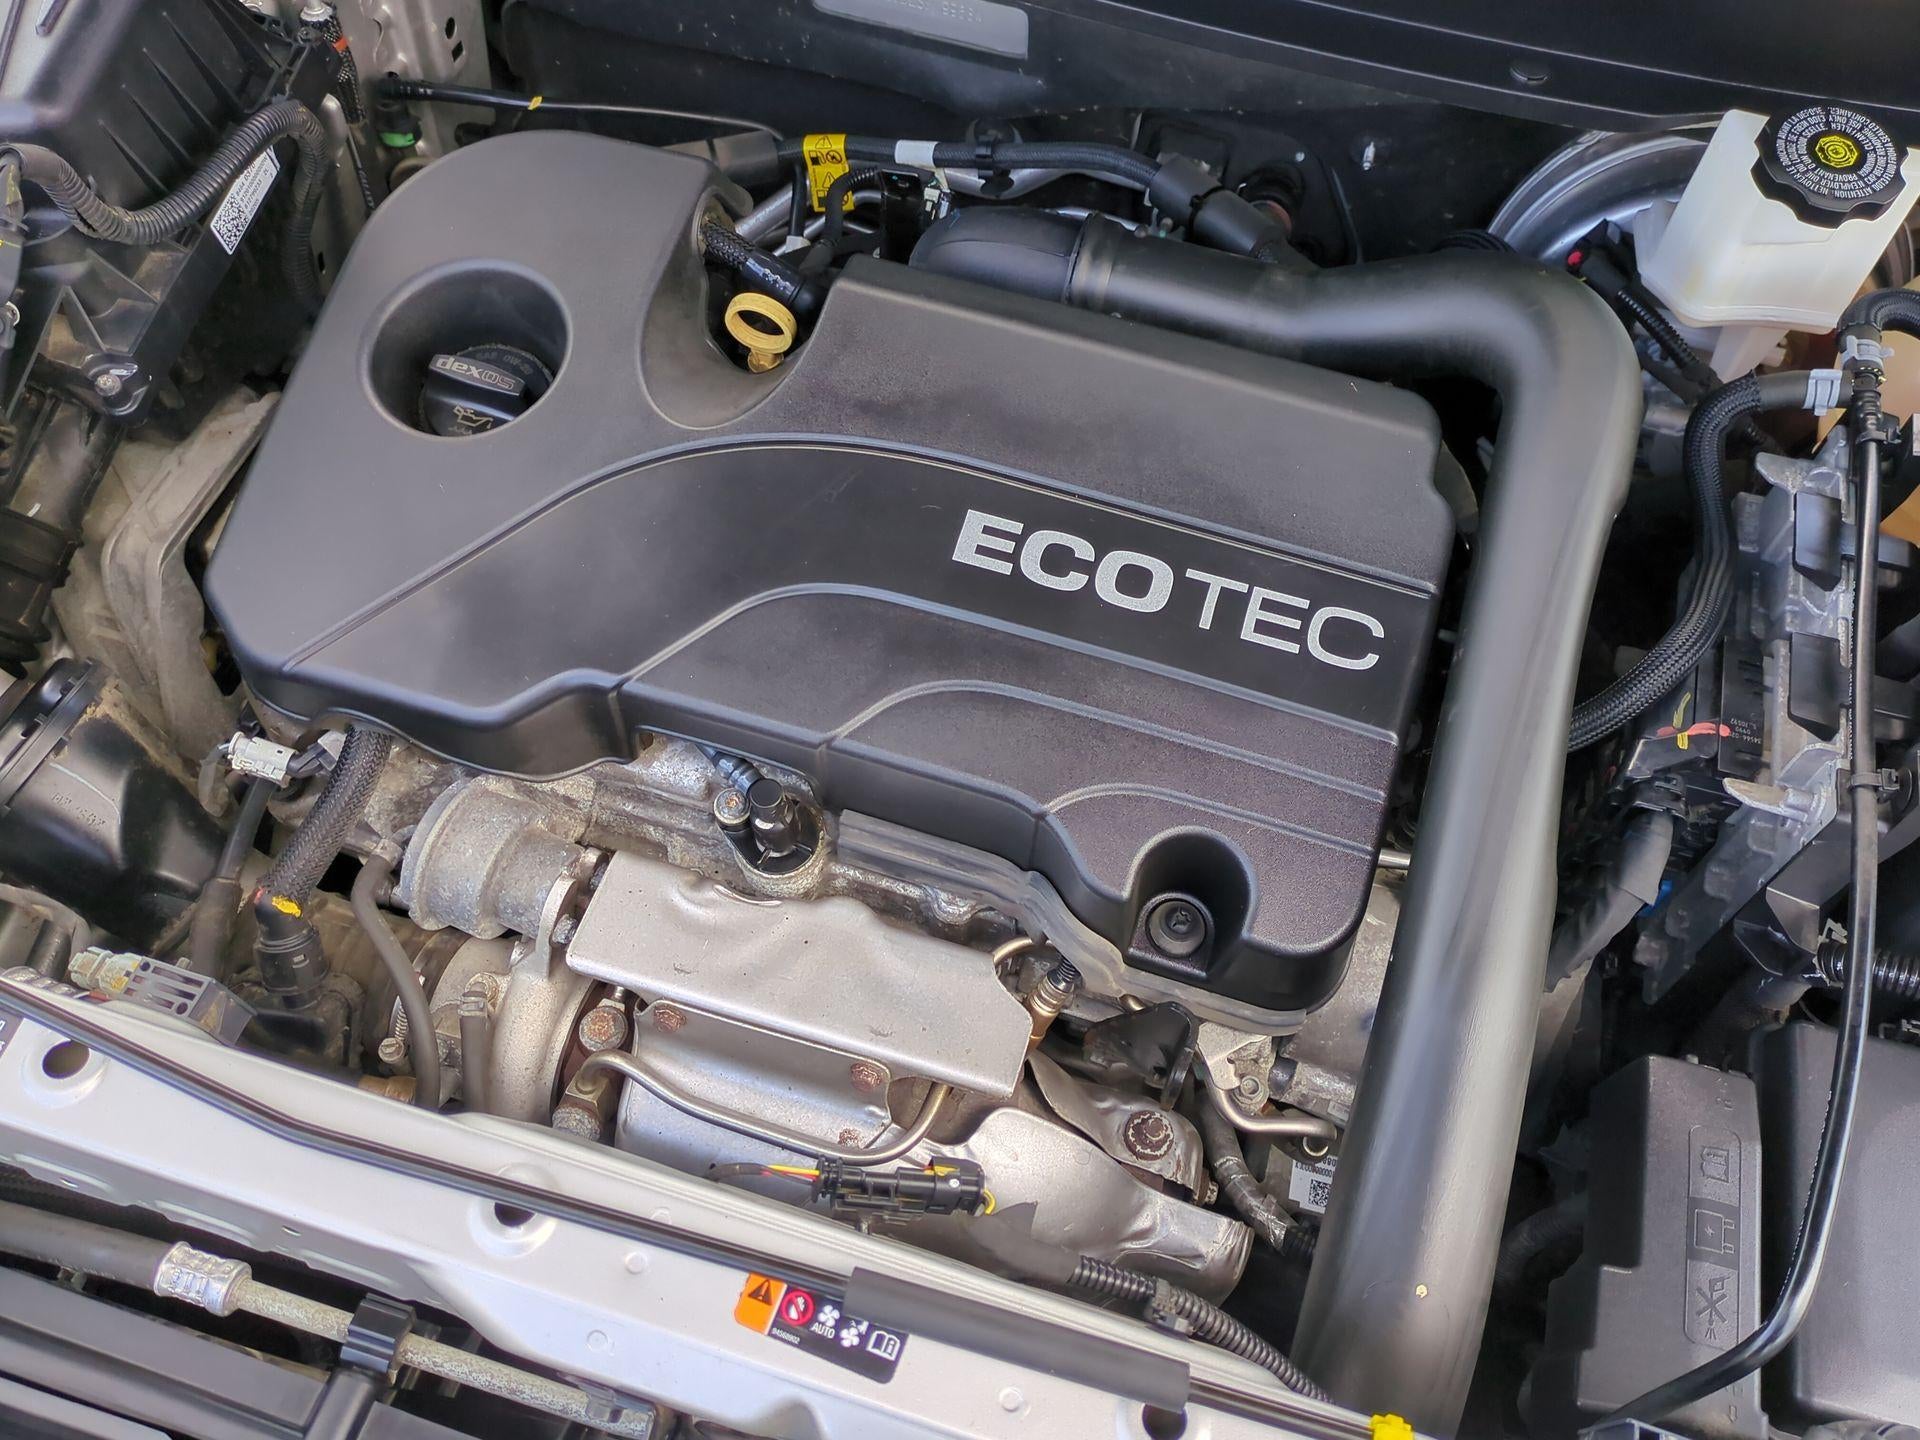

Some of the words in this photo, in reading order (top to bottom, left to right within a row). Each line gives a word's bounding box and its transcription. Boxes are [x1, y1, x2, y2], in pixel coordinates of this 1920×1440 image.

[1789, 116, 1799, 124] LA
[1827, 114, 1847, 123] ONLY
[1847, 118, 1862, 129] USE
[1777, 122, 1792, 138] AVANT
[1791, 120, 1809, 134] FREIN
[1830, 122, 1857, 134] FILLER
[1867, 122, 1890, 142] SEALED
[1787, 133, 1798, 141] DE
[1797, 136, 1807, 153] BIDON
[1854, 131, 1874, 149] CLEAN
[1777, 138, 1791, 165] BOUCHON
[1787, 141, 1800, 163] LIQUIDE
[1886, 147, 1896, 163] FROM
[1785, 165, 1797, 174] LE
[1795, 163, 1807, 172] DU
[1872, 155, 1886, 176] BEFORE
[1882, 163, 1896, 179] FLUID
[1803, 170, 1820, 182] QUE
[1813, 168, 1858, 181] PROVENANT
[1863, 173, 1877, 184] CAP
[1793, 172, 1828, 195] NETTOYER
[435, 355, 516, 390] dexos
[952, 509, 1385, 671] ECOTEC
[810, 1322, 836, 1339] AUTO
